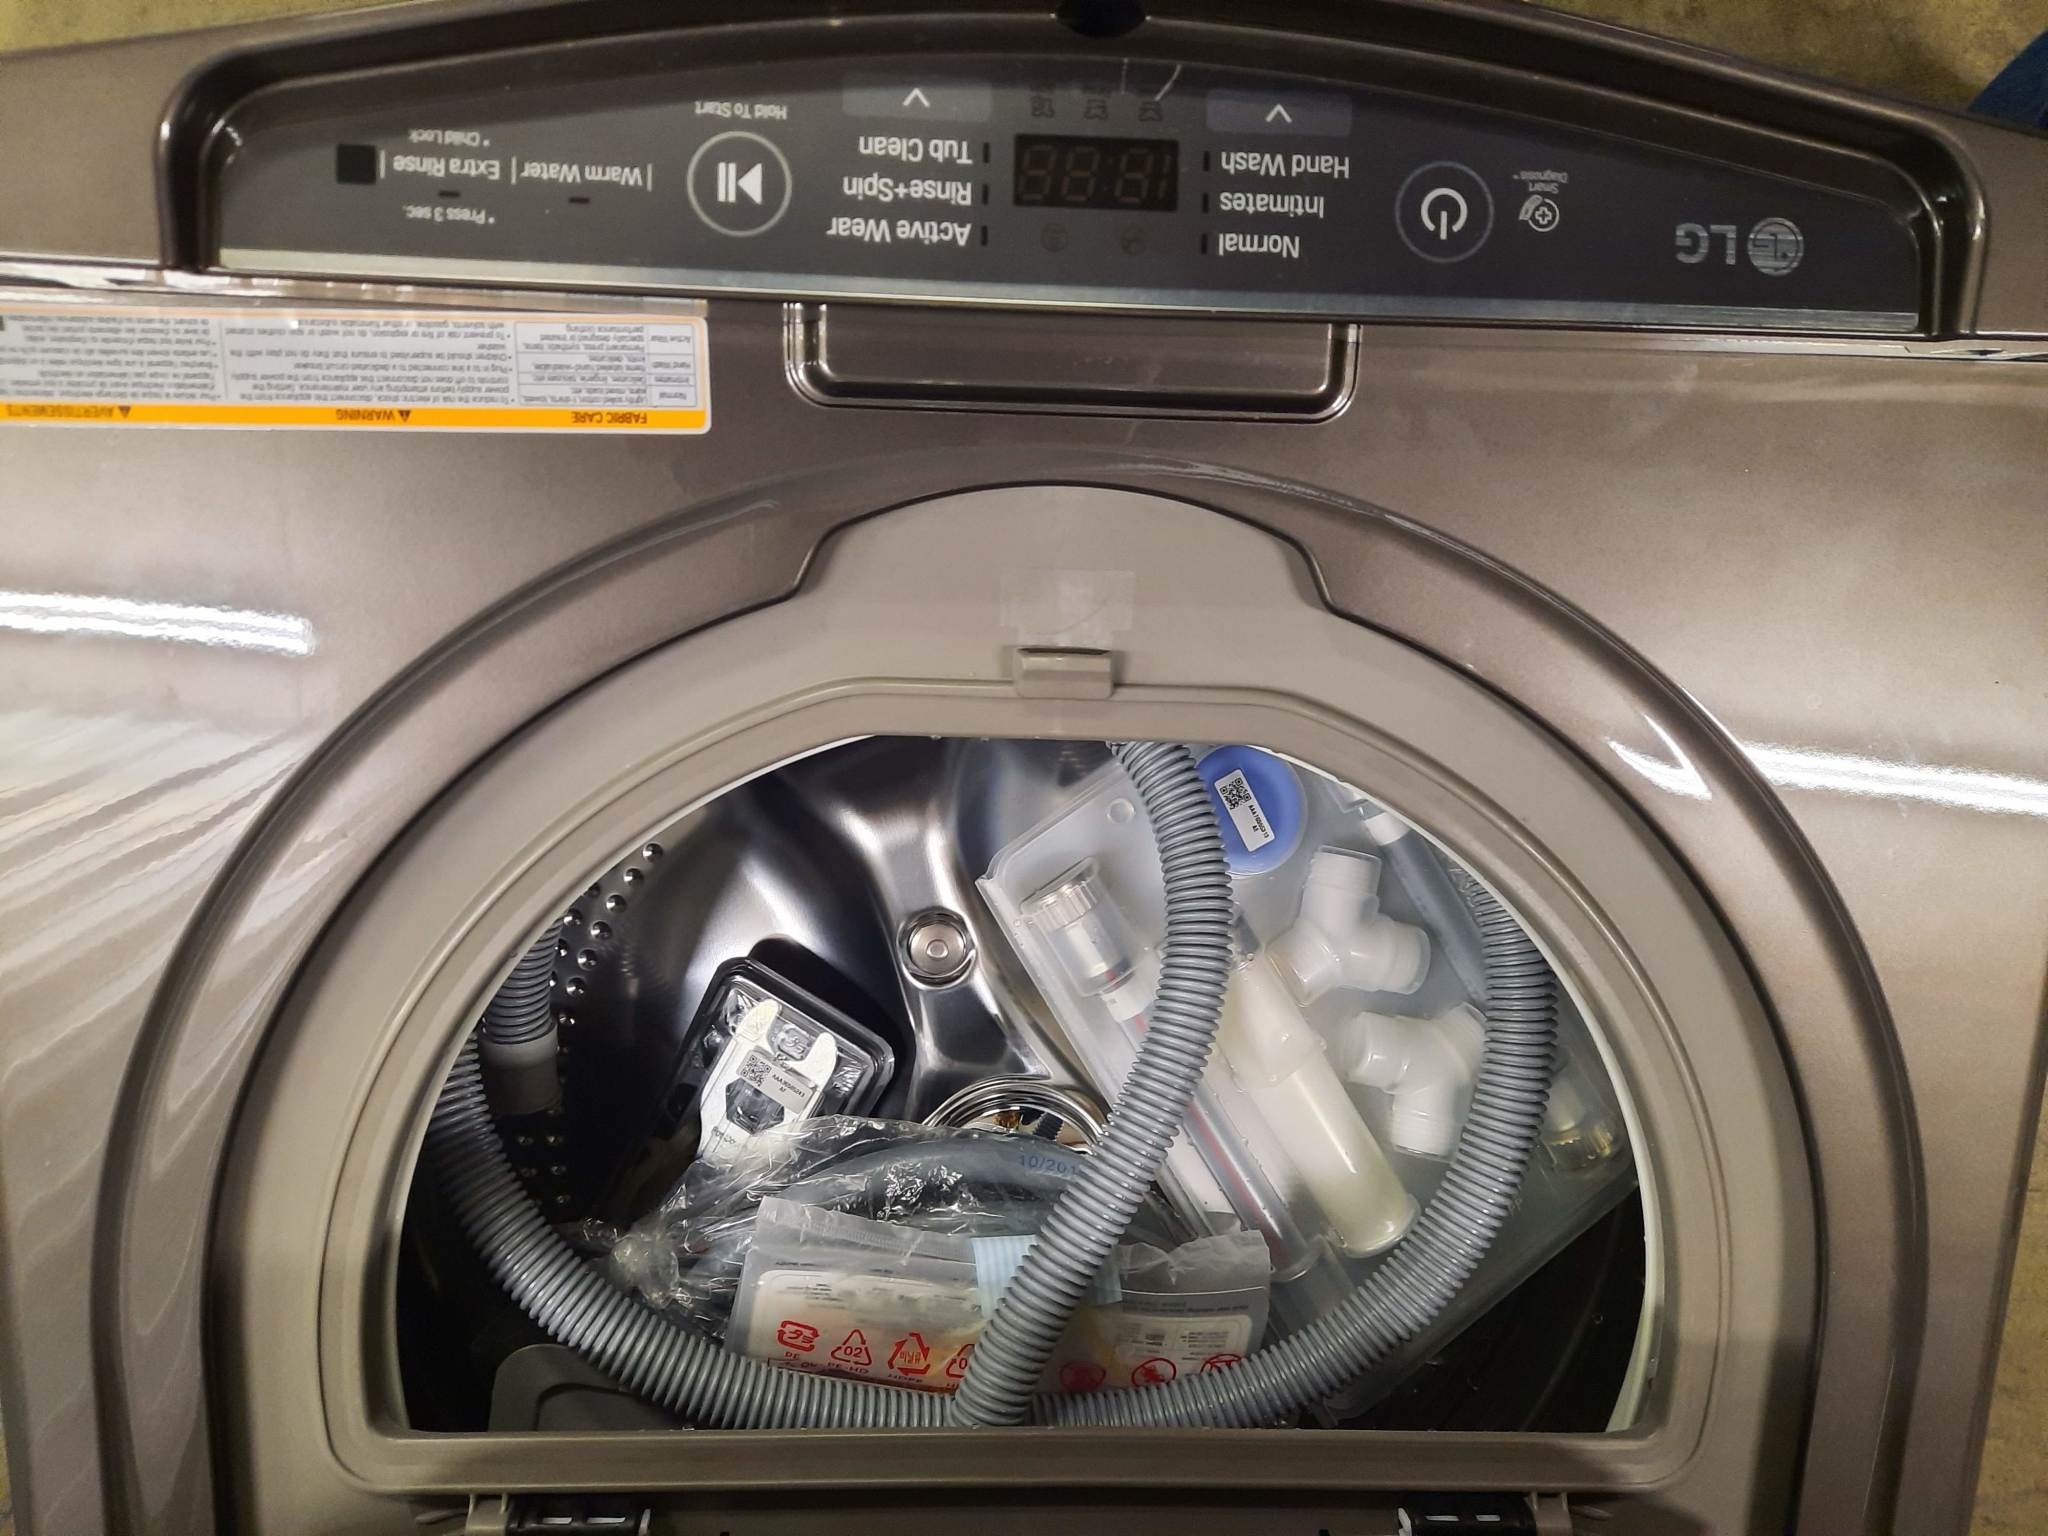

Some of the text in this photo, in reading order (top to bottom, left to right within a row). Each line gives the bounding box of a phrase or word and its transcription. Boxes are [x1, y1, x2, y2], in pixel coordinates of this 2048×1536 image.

[695, 101, 788, 121] Hold To Start
[408, 129, 481, 147] Child Lock
[859, 136, 974, 165] Tub Clean
[393, 155, 500, 180] Extra Rinse
[520, 162, 642, 186] Warm Water
[1221, 151, 1350, 179] Hand Wash
[843, 172, 973, 206] Rinse+Spin
[435, 207, 443, 222] 3
[446, 207, 486, 225] Press
[1220, 192, 1325, 219] Intimates
[825, 217, 972, 246] Active Wear
[1219, 233, 1300, 259] Normal
[1675, 223, 1737, 265] LG
[336, 410, 394, 420] WARNING
[571, 412, 647, 424] FABRIC CARE
[844, 1346, 863, 1358] 02
